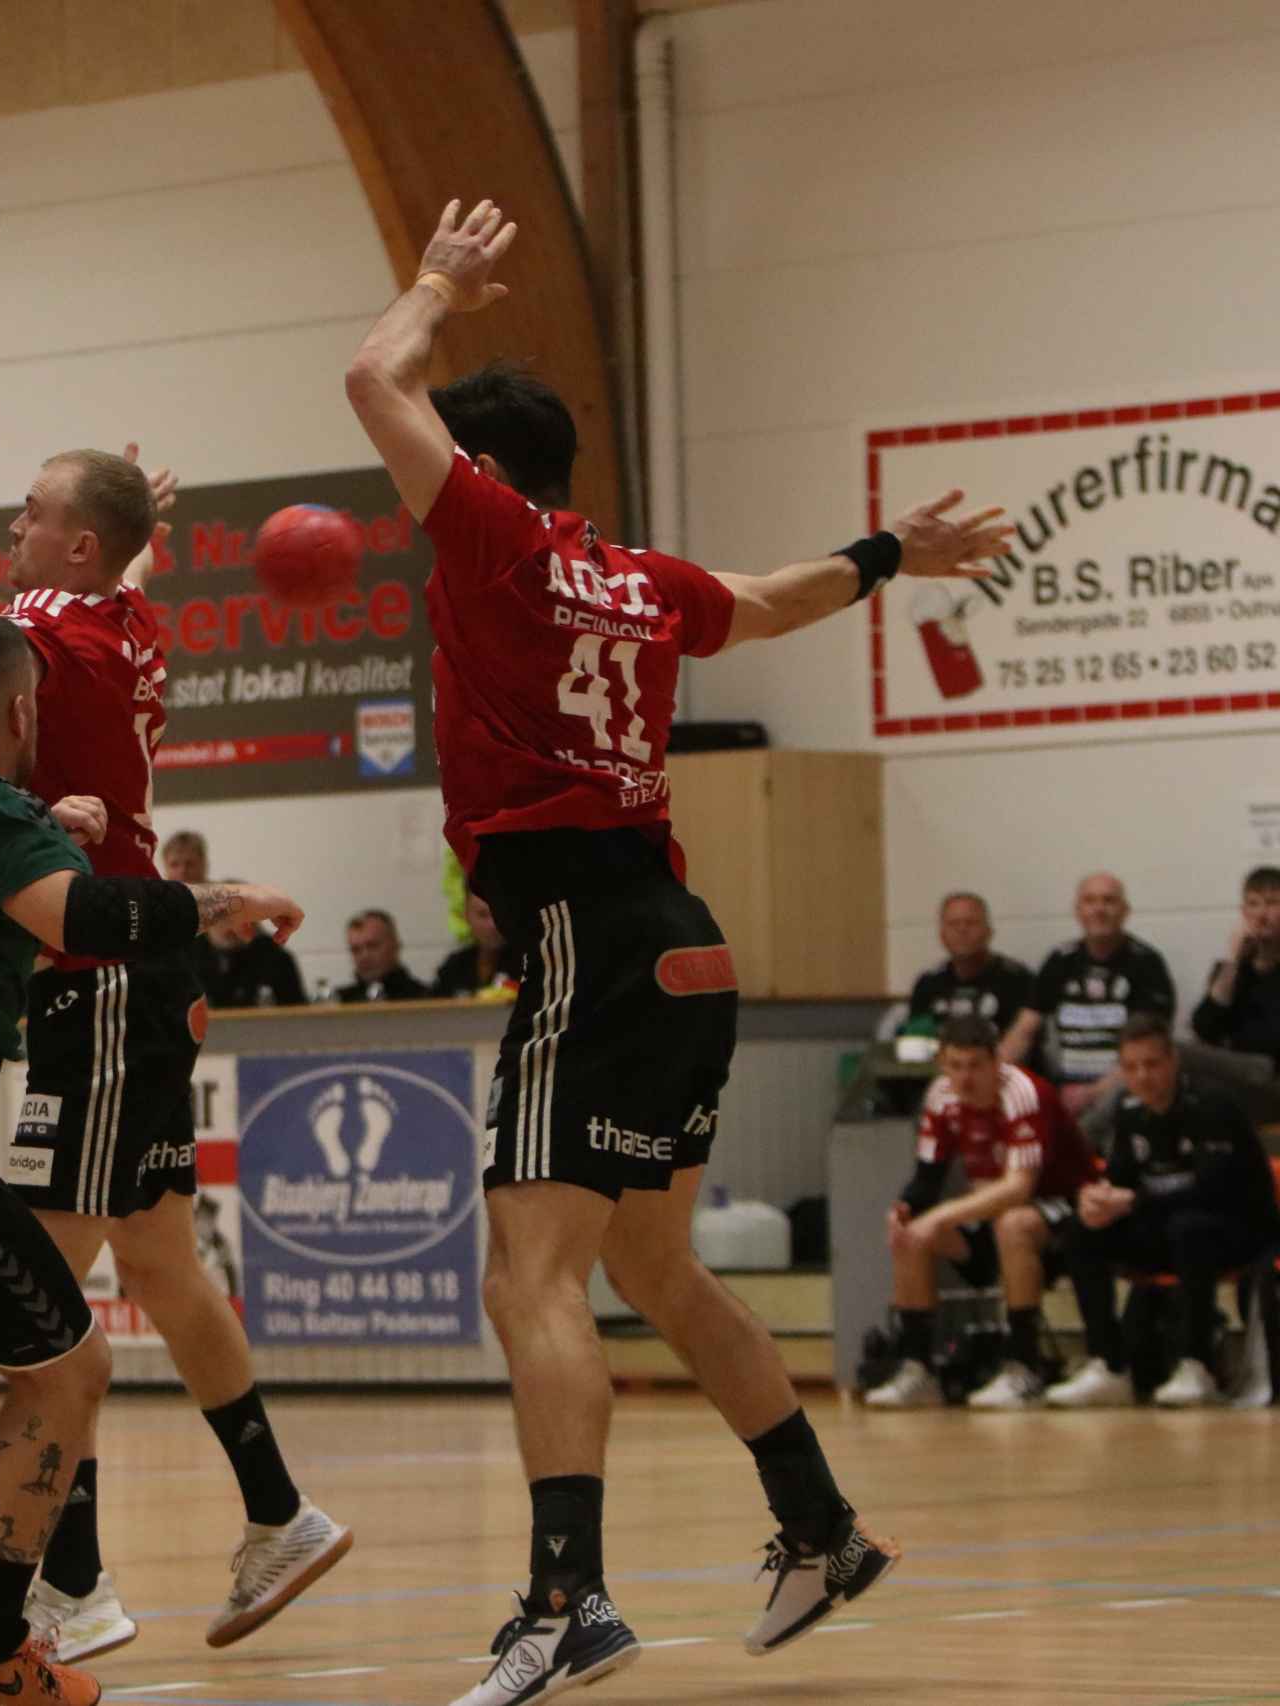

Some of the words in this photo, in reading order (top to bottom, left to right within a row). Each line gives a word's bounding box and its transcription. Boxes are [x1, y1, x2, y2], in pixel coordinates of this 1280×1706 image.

[1032, 559, 1115, 606] B.S.
[1128, 552, 1241, 599] Riber
[230, 660, 307, 703] lokal
[1167, 647, 1199, 676] 23
[557, 632, 653, 764] 41
